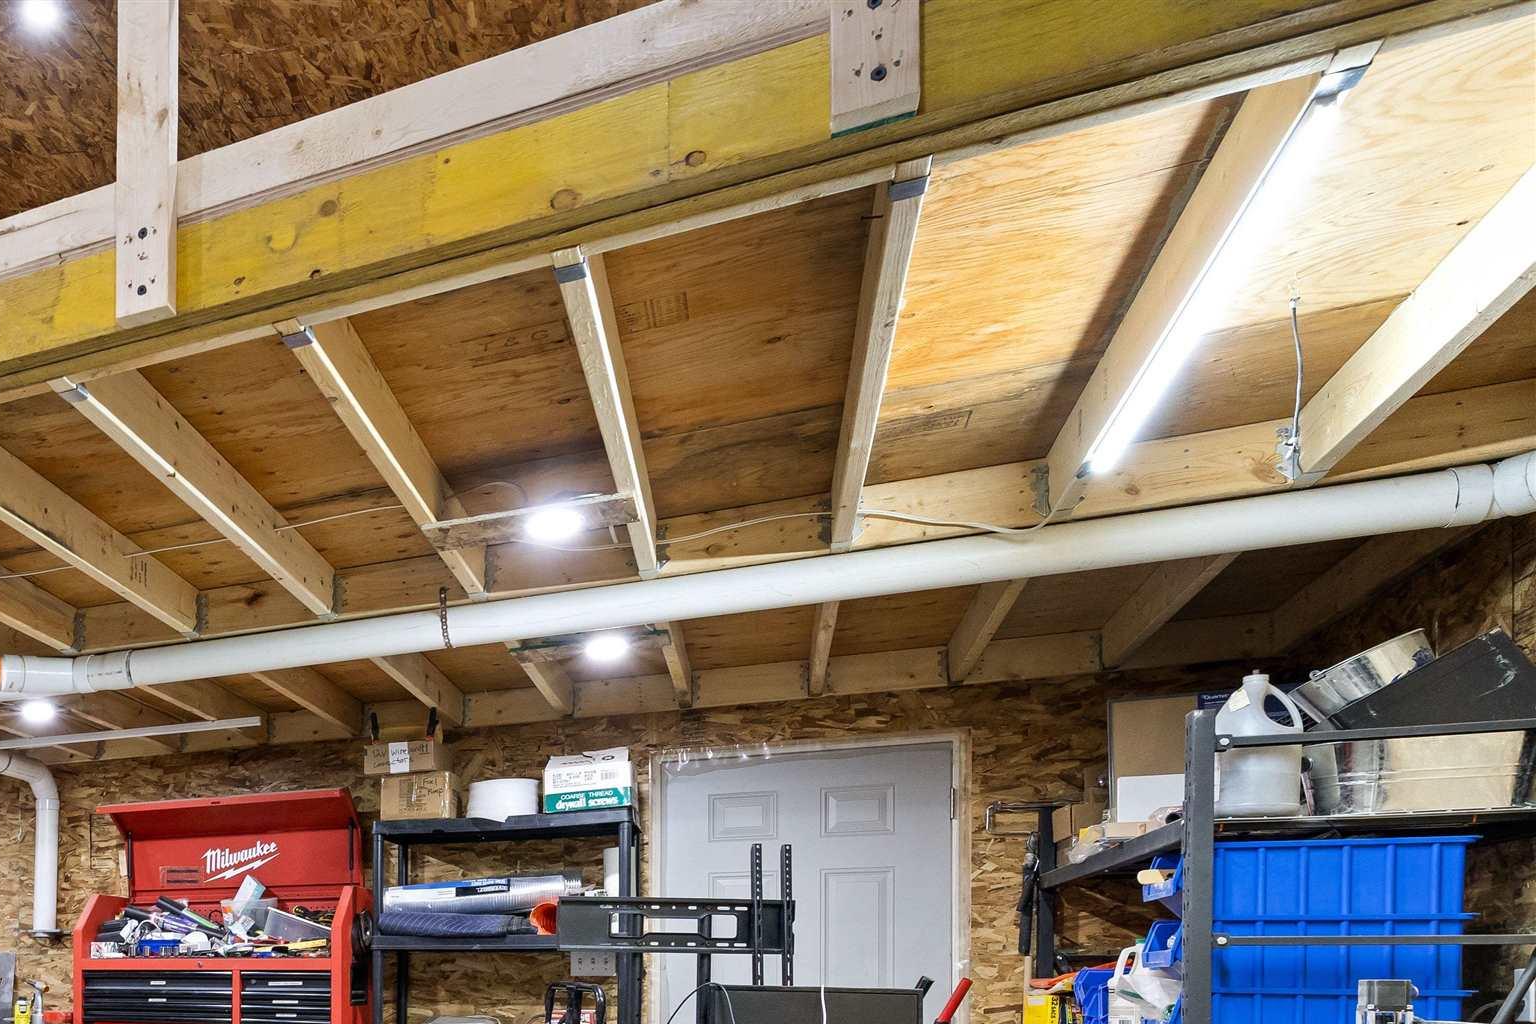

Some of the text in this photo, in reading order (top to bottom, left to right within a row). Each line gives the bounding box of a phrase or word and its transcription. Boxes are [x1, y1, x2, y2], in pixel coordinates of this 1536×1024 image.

[588, 790, 614, 798] THREAD
[555, 797, 587, 811] drywall
[200, 840, 279, 874] Milwaukee
